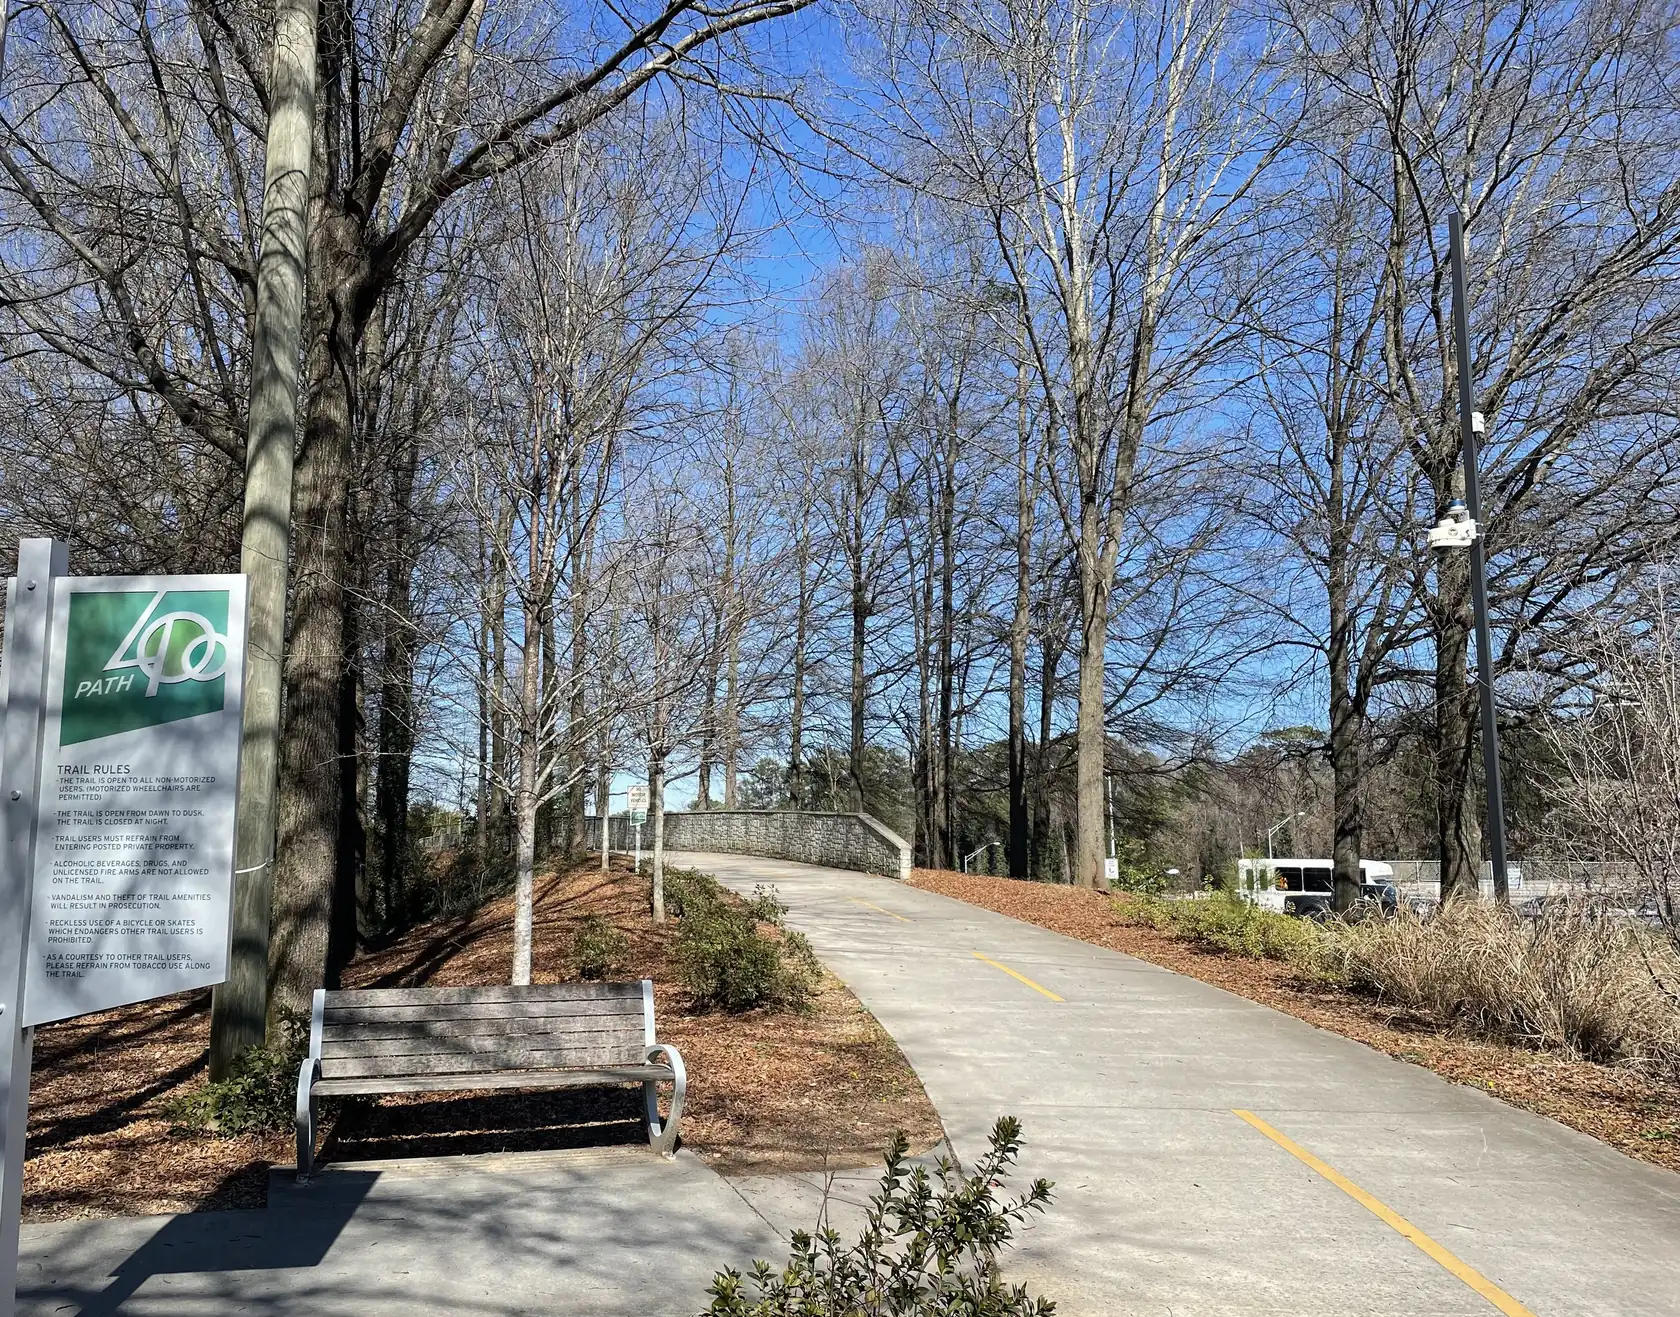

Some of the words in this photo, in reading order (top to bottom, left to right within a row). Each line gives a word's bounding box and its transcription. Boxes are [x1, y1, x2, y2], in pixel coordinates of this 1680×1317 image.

[74, 674, 135, 698] PATH
[57, 765, 90, 774] TRAIL
[93, 764, 130, 774] RULES
[53, 868, 99, 876] UNLICENSED
[100, 868, 116, 876] FIRE
[118, 868, 140, 876] ARMS
[141, 868, 156, 876] ARE
[158, 868, 173, 876] NOT
[173, 868, 209, 876] ALLOWED
[47, 936, 93, 944] PROHIBITED.
